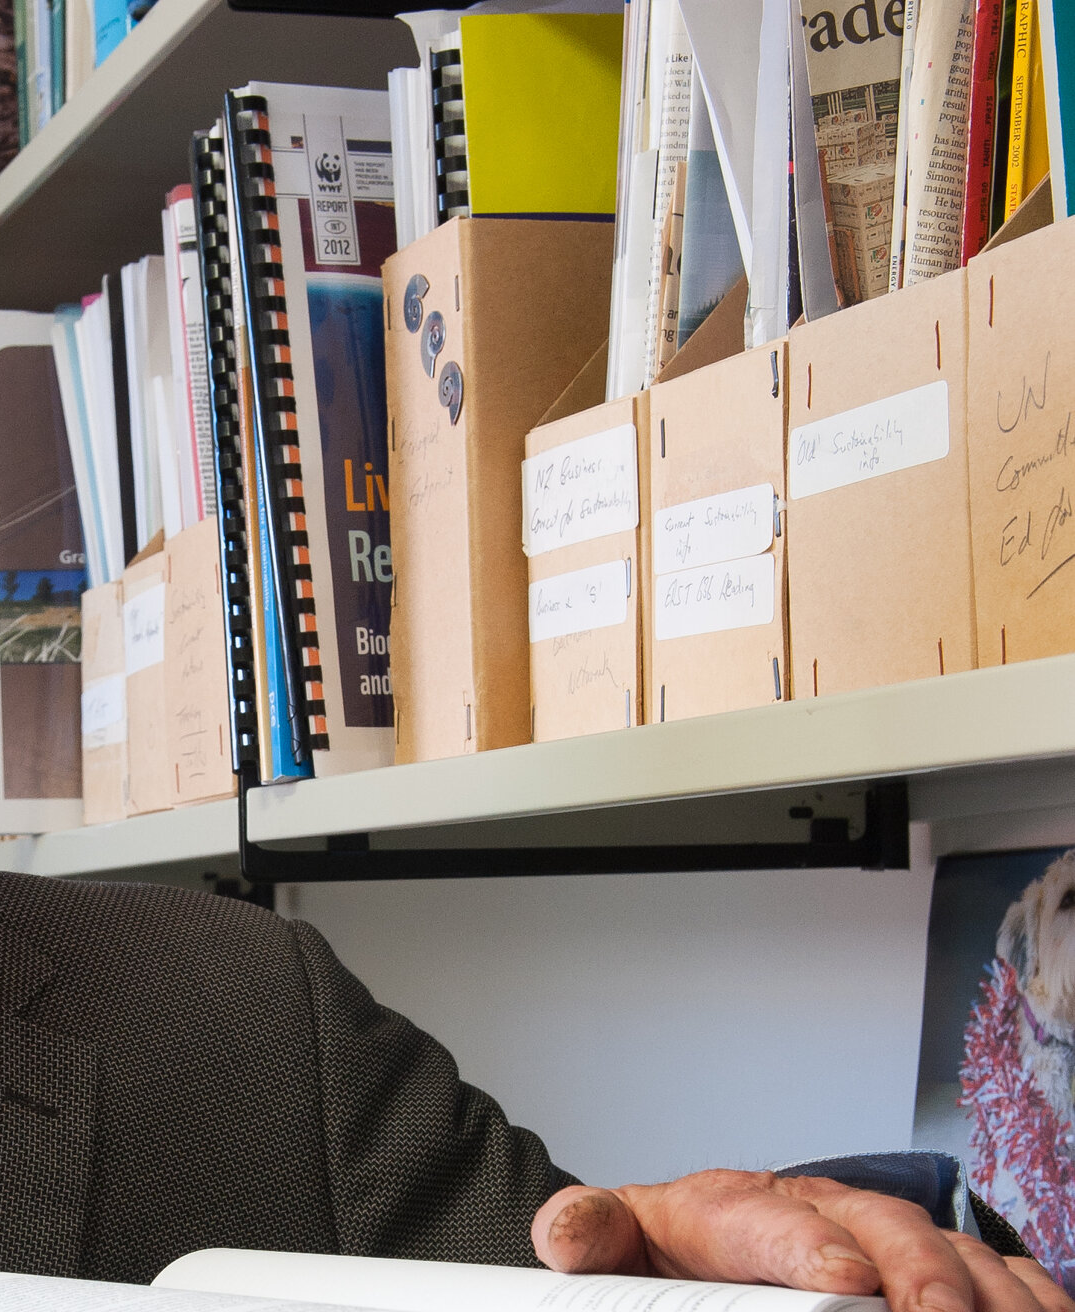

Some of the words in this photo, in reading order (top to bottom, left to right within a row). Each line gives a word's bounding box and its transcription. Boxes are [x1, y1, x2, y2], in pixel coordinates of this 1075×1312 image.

[1012, 75, 1024, 142] SEPTEMBER
[1011, 143, 1021, 169] 2002
[926, 171, 955, 184] Simon
[318, 183, 342, 194] WWF
[317, 200, 349, 213] REPORT
[324, 239, 351, 256] 2012
